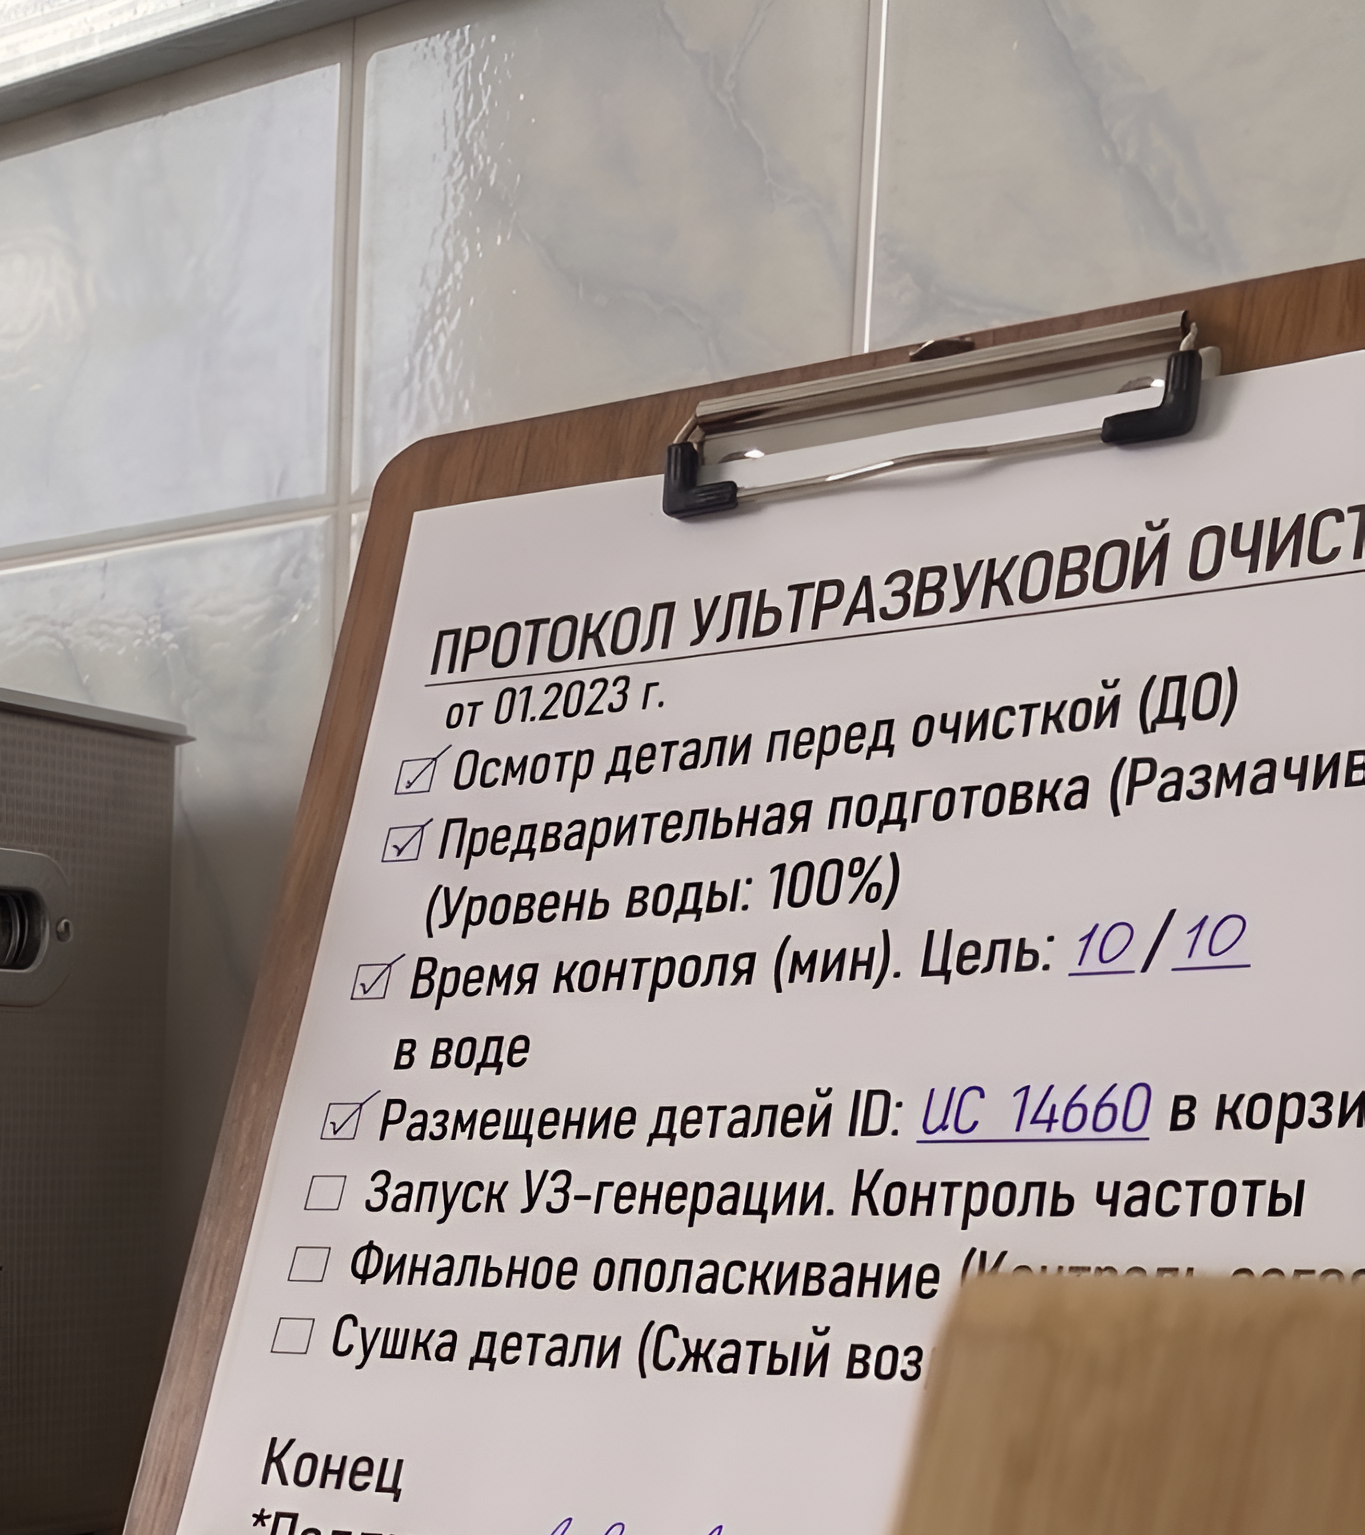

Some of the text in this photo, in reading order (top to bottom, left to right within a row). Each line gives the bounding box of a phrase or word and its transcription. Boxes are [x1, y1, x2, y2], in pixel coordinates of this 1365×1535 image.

[431, 601, 676, 675] ПРОТОКОЛ
[690, 518, 1170, 646] УЛЬТРАЗВУКОВОЙ
[446, 675, 664, 729] от 01.2023 г.
[454, 666, 1237, 793] Осмотр детали перед очисткой (ДО)
[439, 800, 813, 870] Предварительная
[828, 775, 1089, 834] подготовка
[426, 852, 899, 939] (Уровень воды: 100%)
[410, 957, 539, 1010] Время
[553, 952, 756, 1002] контроля
[774, 929, 900, 993] (мин).
[921, 929, 1054, 985] Цель:
[394, 1035, 530, 1076] в воде
[379, 1099, 636, 1148] Размещение
[647, 1087, 832, 1147] деталей
[849, 1089, 903, 1136] ID:
[1012, 1082, 1152, 1134] 14660
[1170, 1095, 1196, 1131] в
[365, 1170, 508, 1224] Запуск
[851, 1169, 1074, 1230] Контроль
[1096, 1179, 1305, 1217] частоты
[351, 1240, 578, 1290] Финальное
[593, 1257, 940, 1299] ополаскивание
[333, 1314, 936, 1390] Сушка детали (Сжатый воз
[261, 1437, 404, 1502] Конец
